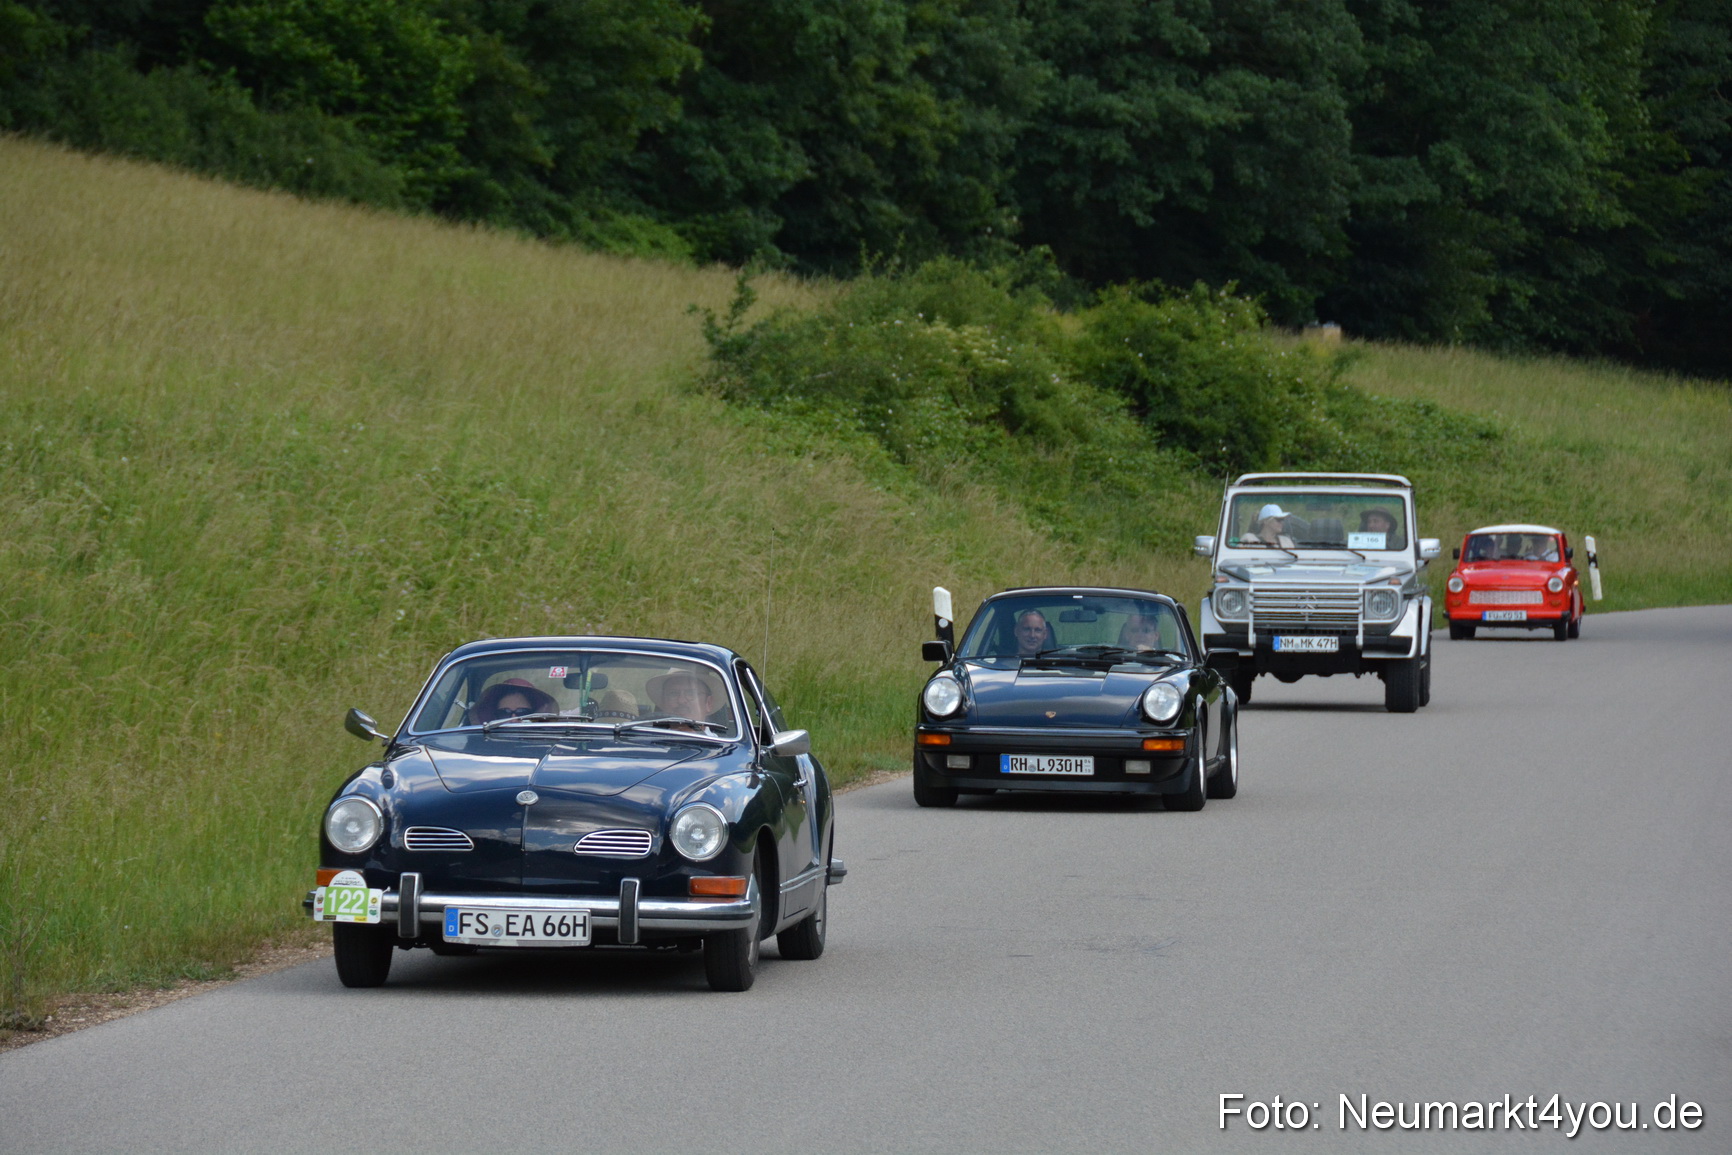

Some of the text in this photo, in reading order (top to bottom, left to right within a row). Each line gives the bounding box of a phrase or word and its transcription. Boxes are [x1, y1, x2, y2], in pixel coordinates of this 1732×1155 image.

[1280, 638, 1337, 648] NM MK 47H
[1010, 758, 1027, 771] RH
[1037, 758, 1045, 772] L
[328, 889, 365, 914] 122
[459, 912, 587, 939] FS EA 66H
